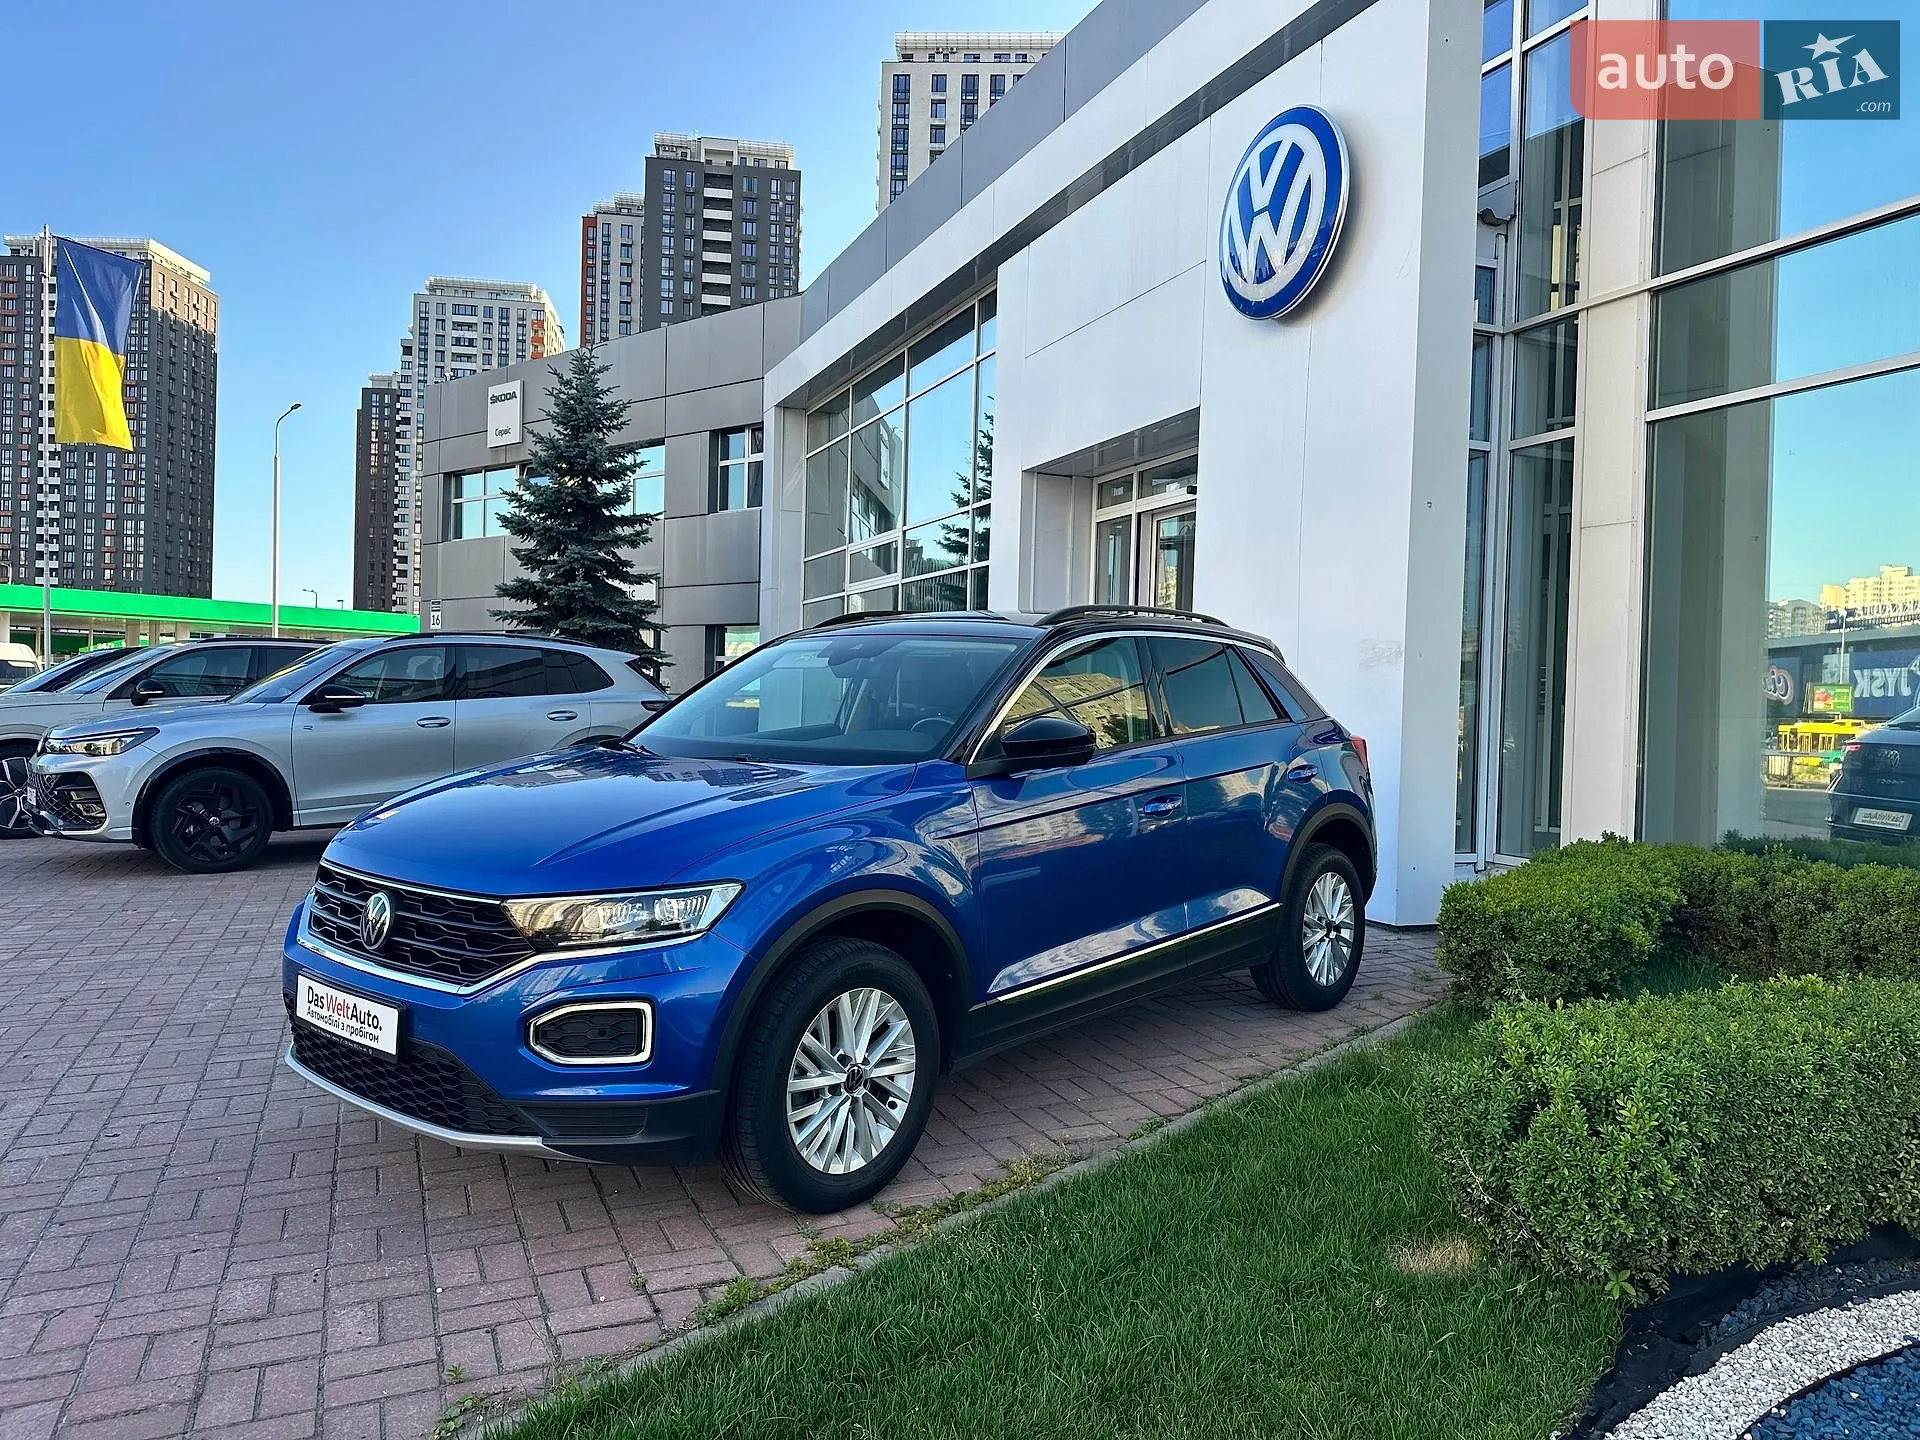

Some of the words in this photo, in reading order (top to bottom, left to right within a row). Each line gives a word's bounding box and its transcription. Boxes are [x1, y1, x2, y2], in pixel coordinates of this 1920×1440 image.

[431, 614, 441, 626] 16
[307, 986, 325, 1010] Das
[307, 1006, 340, 1030] Автомобілі
[345, 1024, 380, 1044] пробігом
